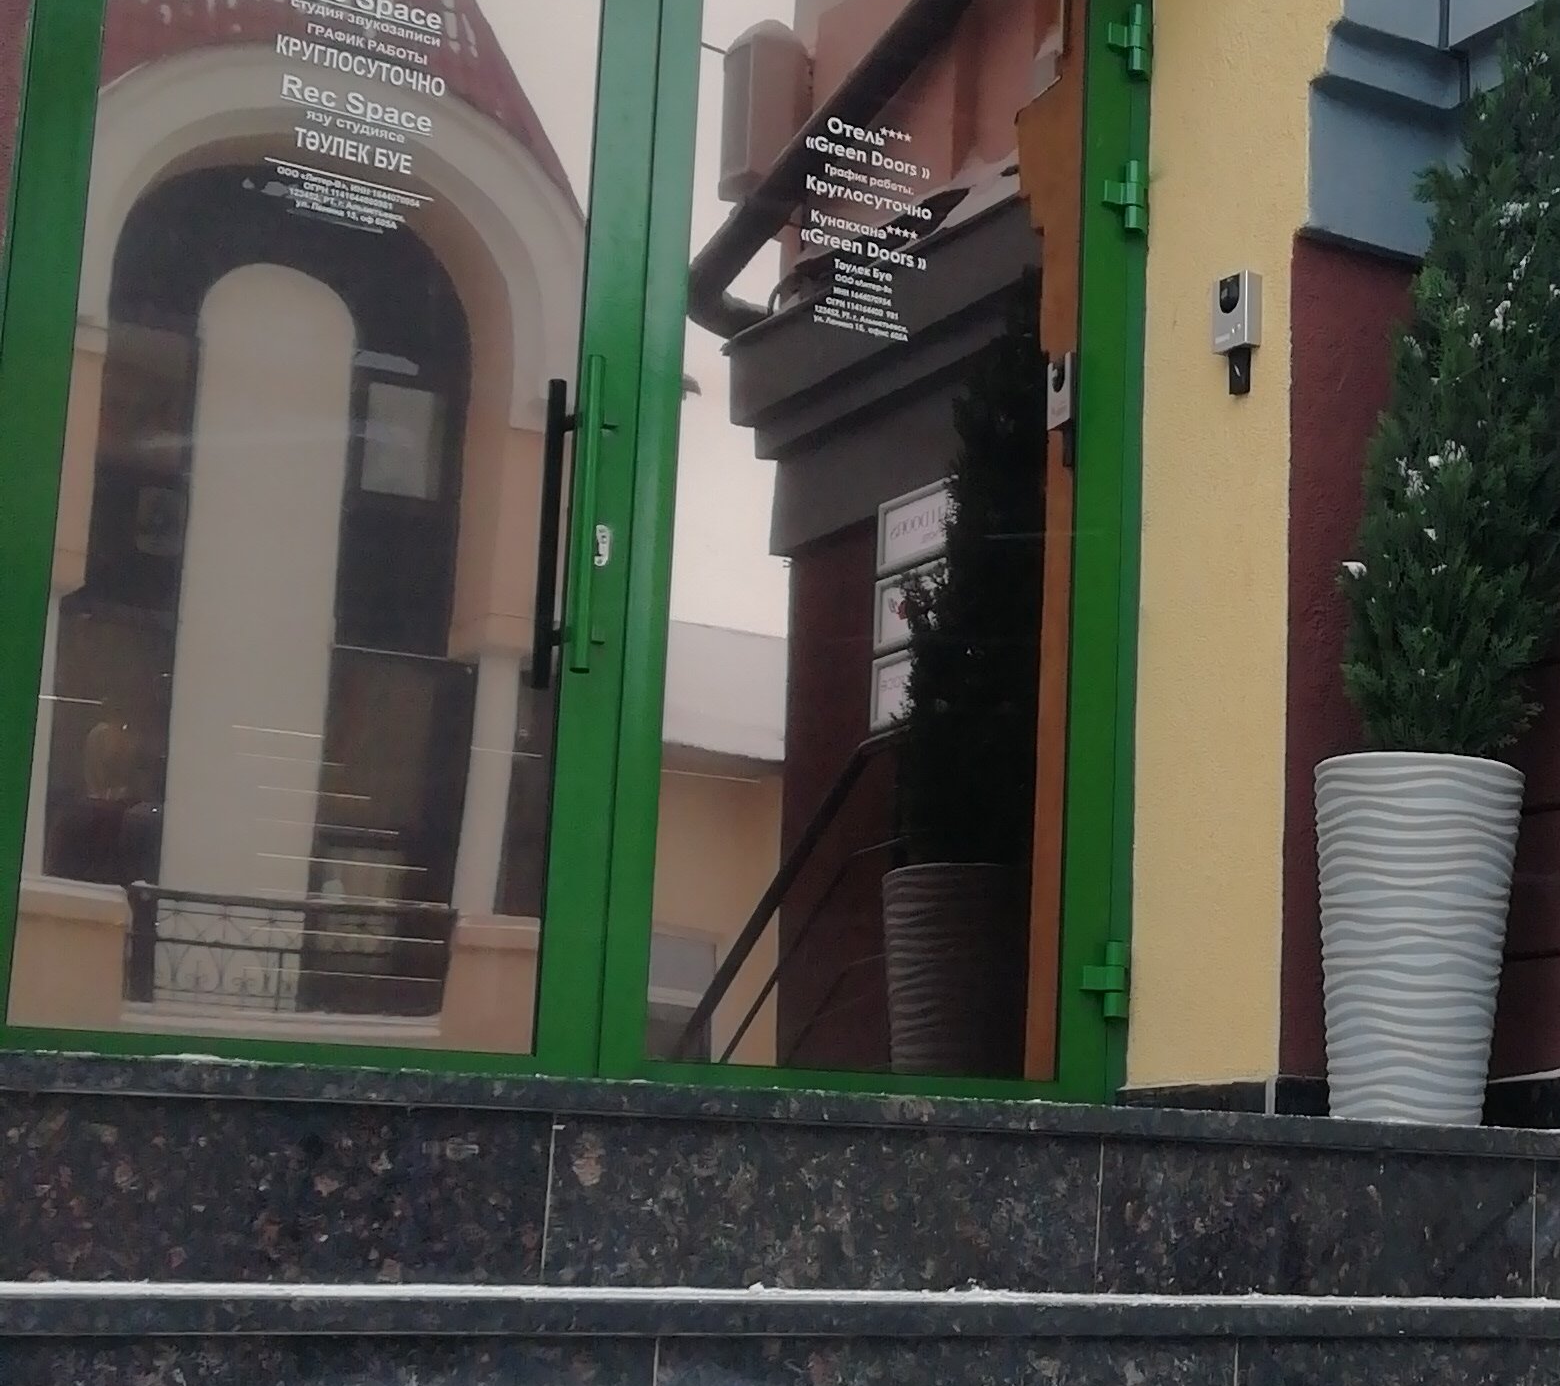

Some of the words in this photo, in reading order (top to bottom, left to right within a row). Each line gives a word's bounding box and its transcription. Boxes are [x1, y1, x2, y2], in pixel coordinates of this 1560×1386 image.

[306, 22, 367, 47] ГРАФИК
[367, 39, 428, 66] РАБОТЫ
[346, 14, 442, 48] звукозаписи
[275, 33, 446, 97] КРУГЛОСУТОЧНО
[281, 73, 337, 108] Rec
[345, 91, 433, 132] Space
[306, 111, 332, 127] язу
[294, 126, 372, 165] ТӘУЛЕК
[373, 147, 413, 175] БУЕ
[827, 116, 885, 147] Отель
[276, 165, 300, 179] ООО
[824, 162, 868, 183] График
[805, 174, 933, 220] Круглосуточно
